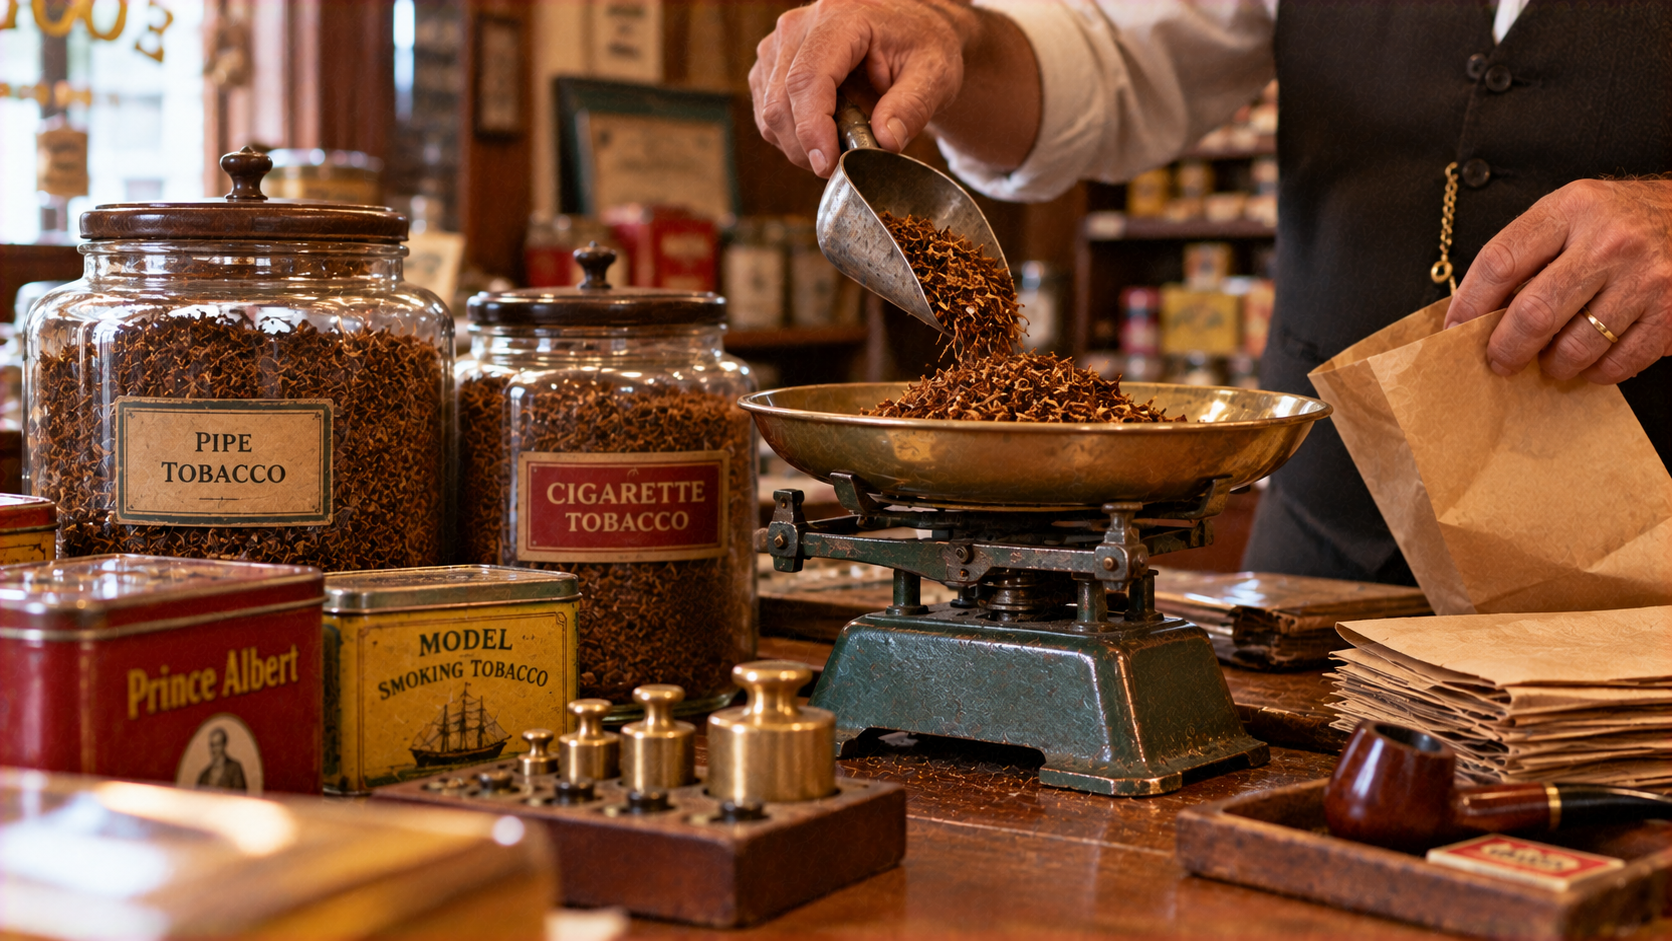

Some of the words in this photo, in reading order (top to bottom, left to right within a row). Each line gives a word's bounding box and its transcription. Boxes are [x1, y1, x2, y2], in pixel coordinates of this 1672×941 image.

[194, 431, 253, 453] PIPE
[161, 461, 287, 484] TOBACCO
[546, 480, 706, 506] CIGARETTE
[565, 510, 690, 533] TOBACCO
[418, 628, 514, 657] MODEL
[127, 663, 217, 721] Prince
[222, 643, 300, 698] Albert
[377, 661, 464, 701] SMOKING
[470, 659, 549, 688] TOBACCO
